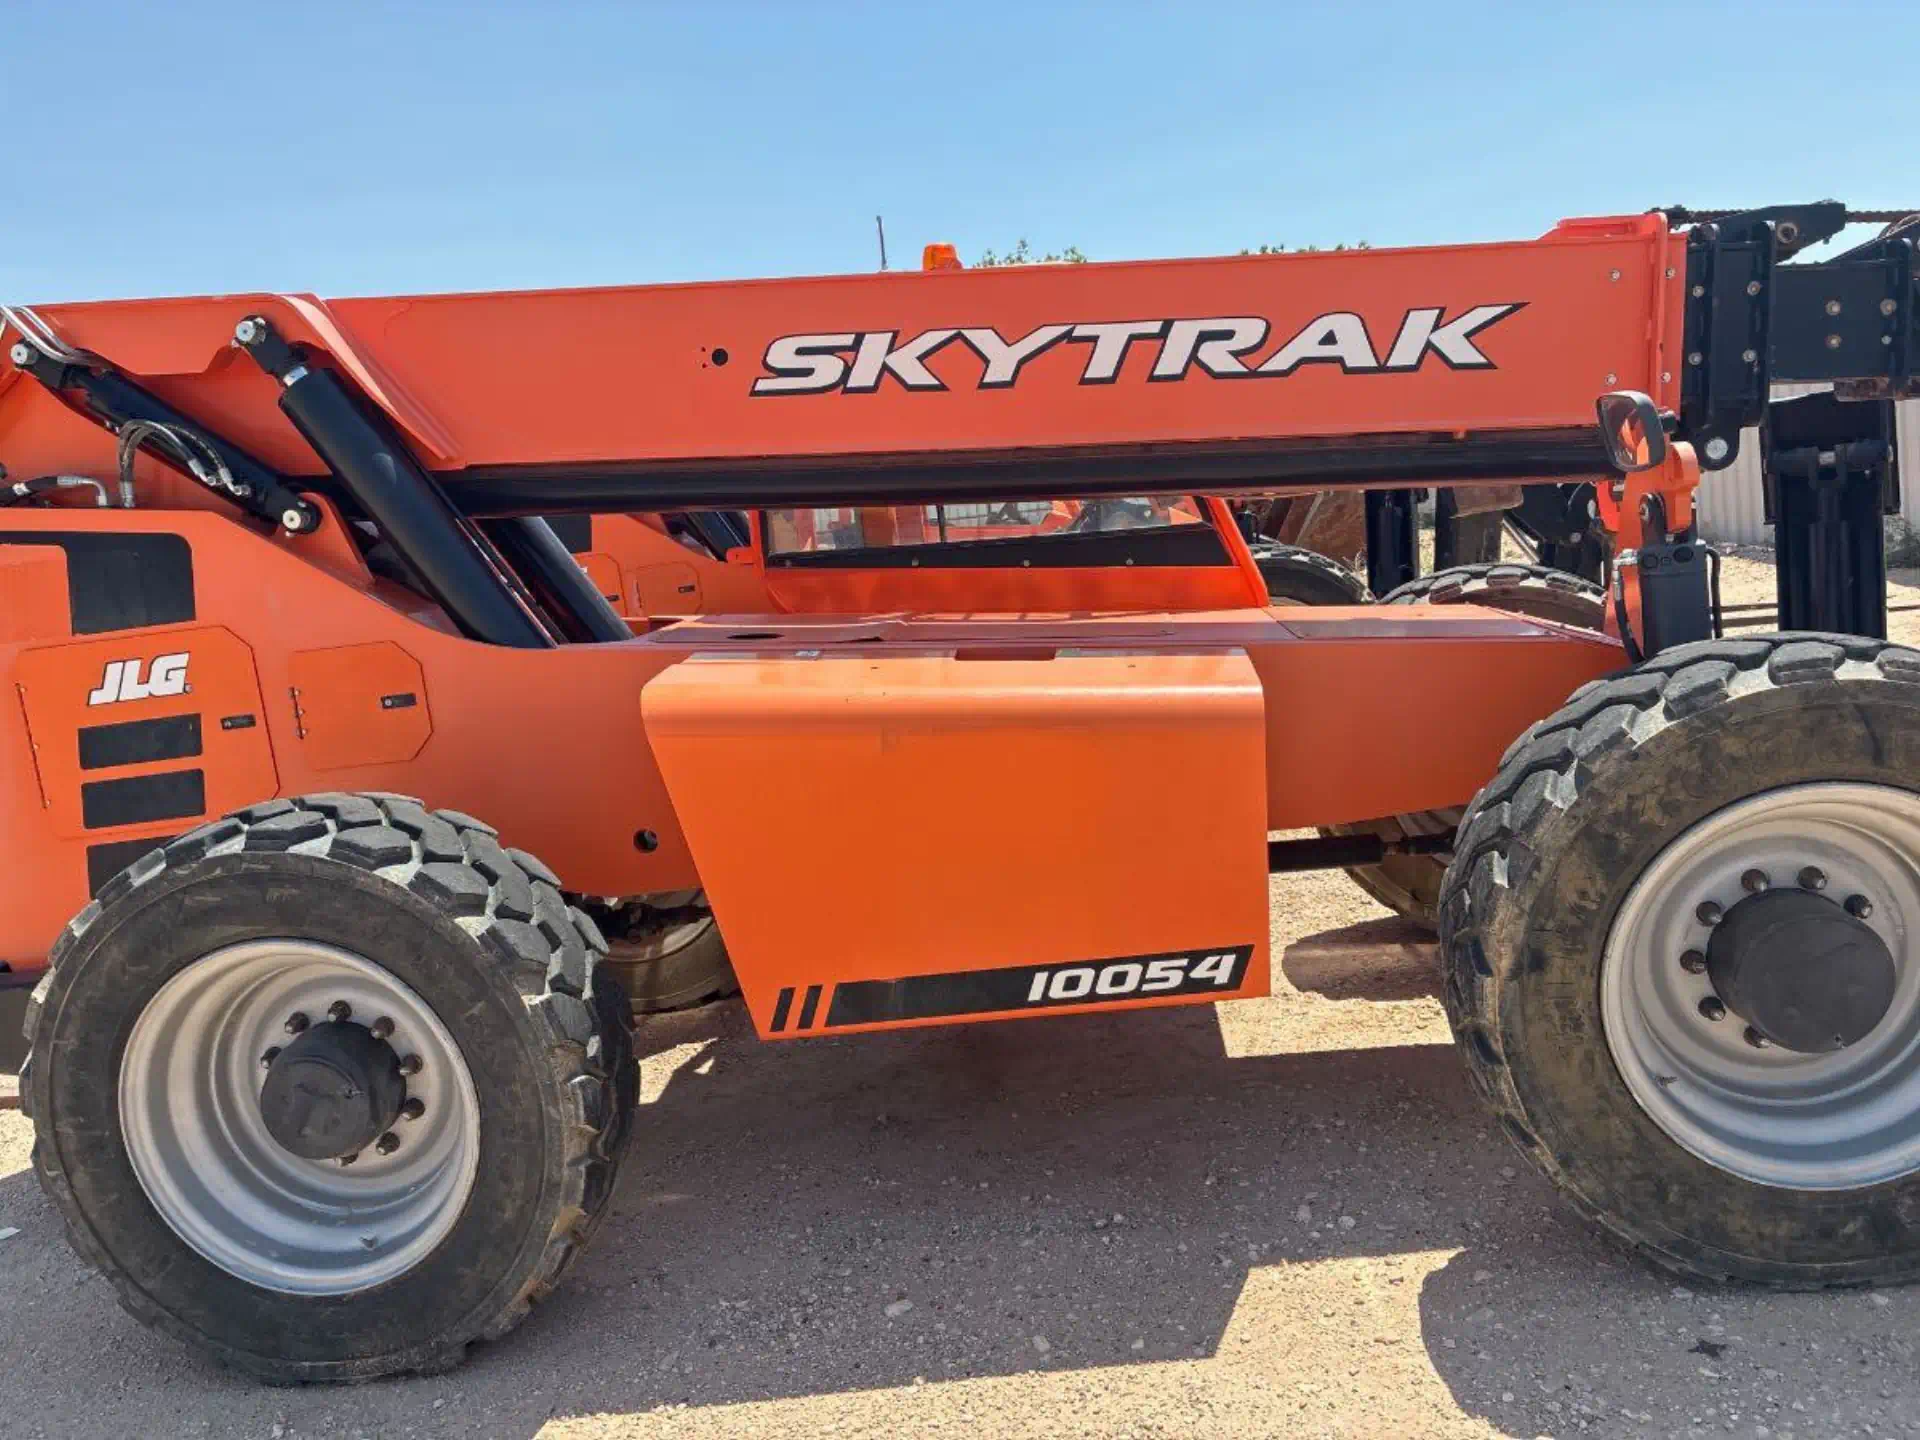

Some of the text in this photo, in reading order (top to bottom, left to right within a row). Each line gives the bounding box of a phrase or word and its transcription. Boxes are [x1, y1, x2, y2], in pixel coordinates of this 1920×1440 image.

[750, 302, 1529, 396] SKYTRAK
[87, 651, 191, 706] JLG
[1028, 953, 1236, 1001] 10054
